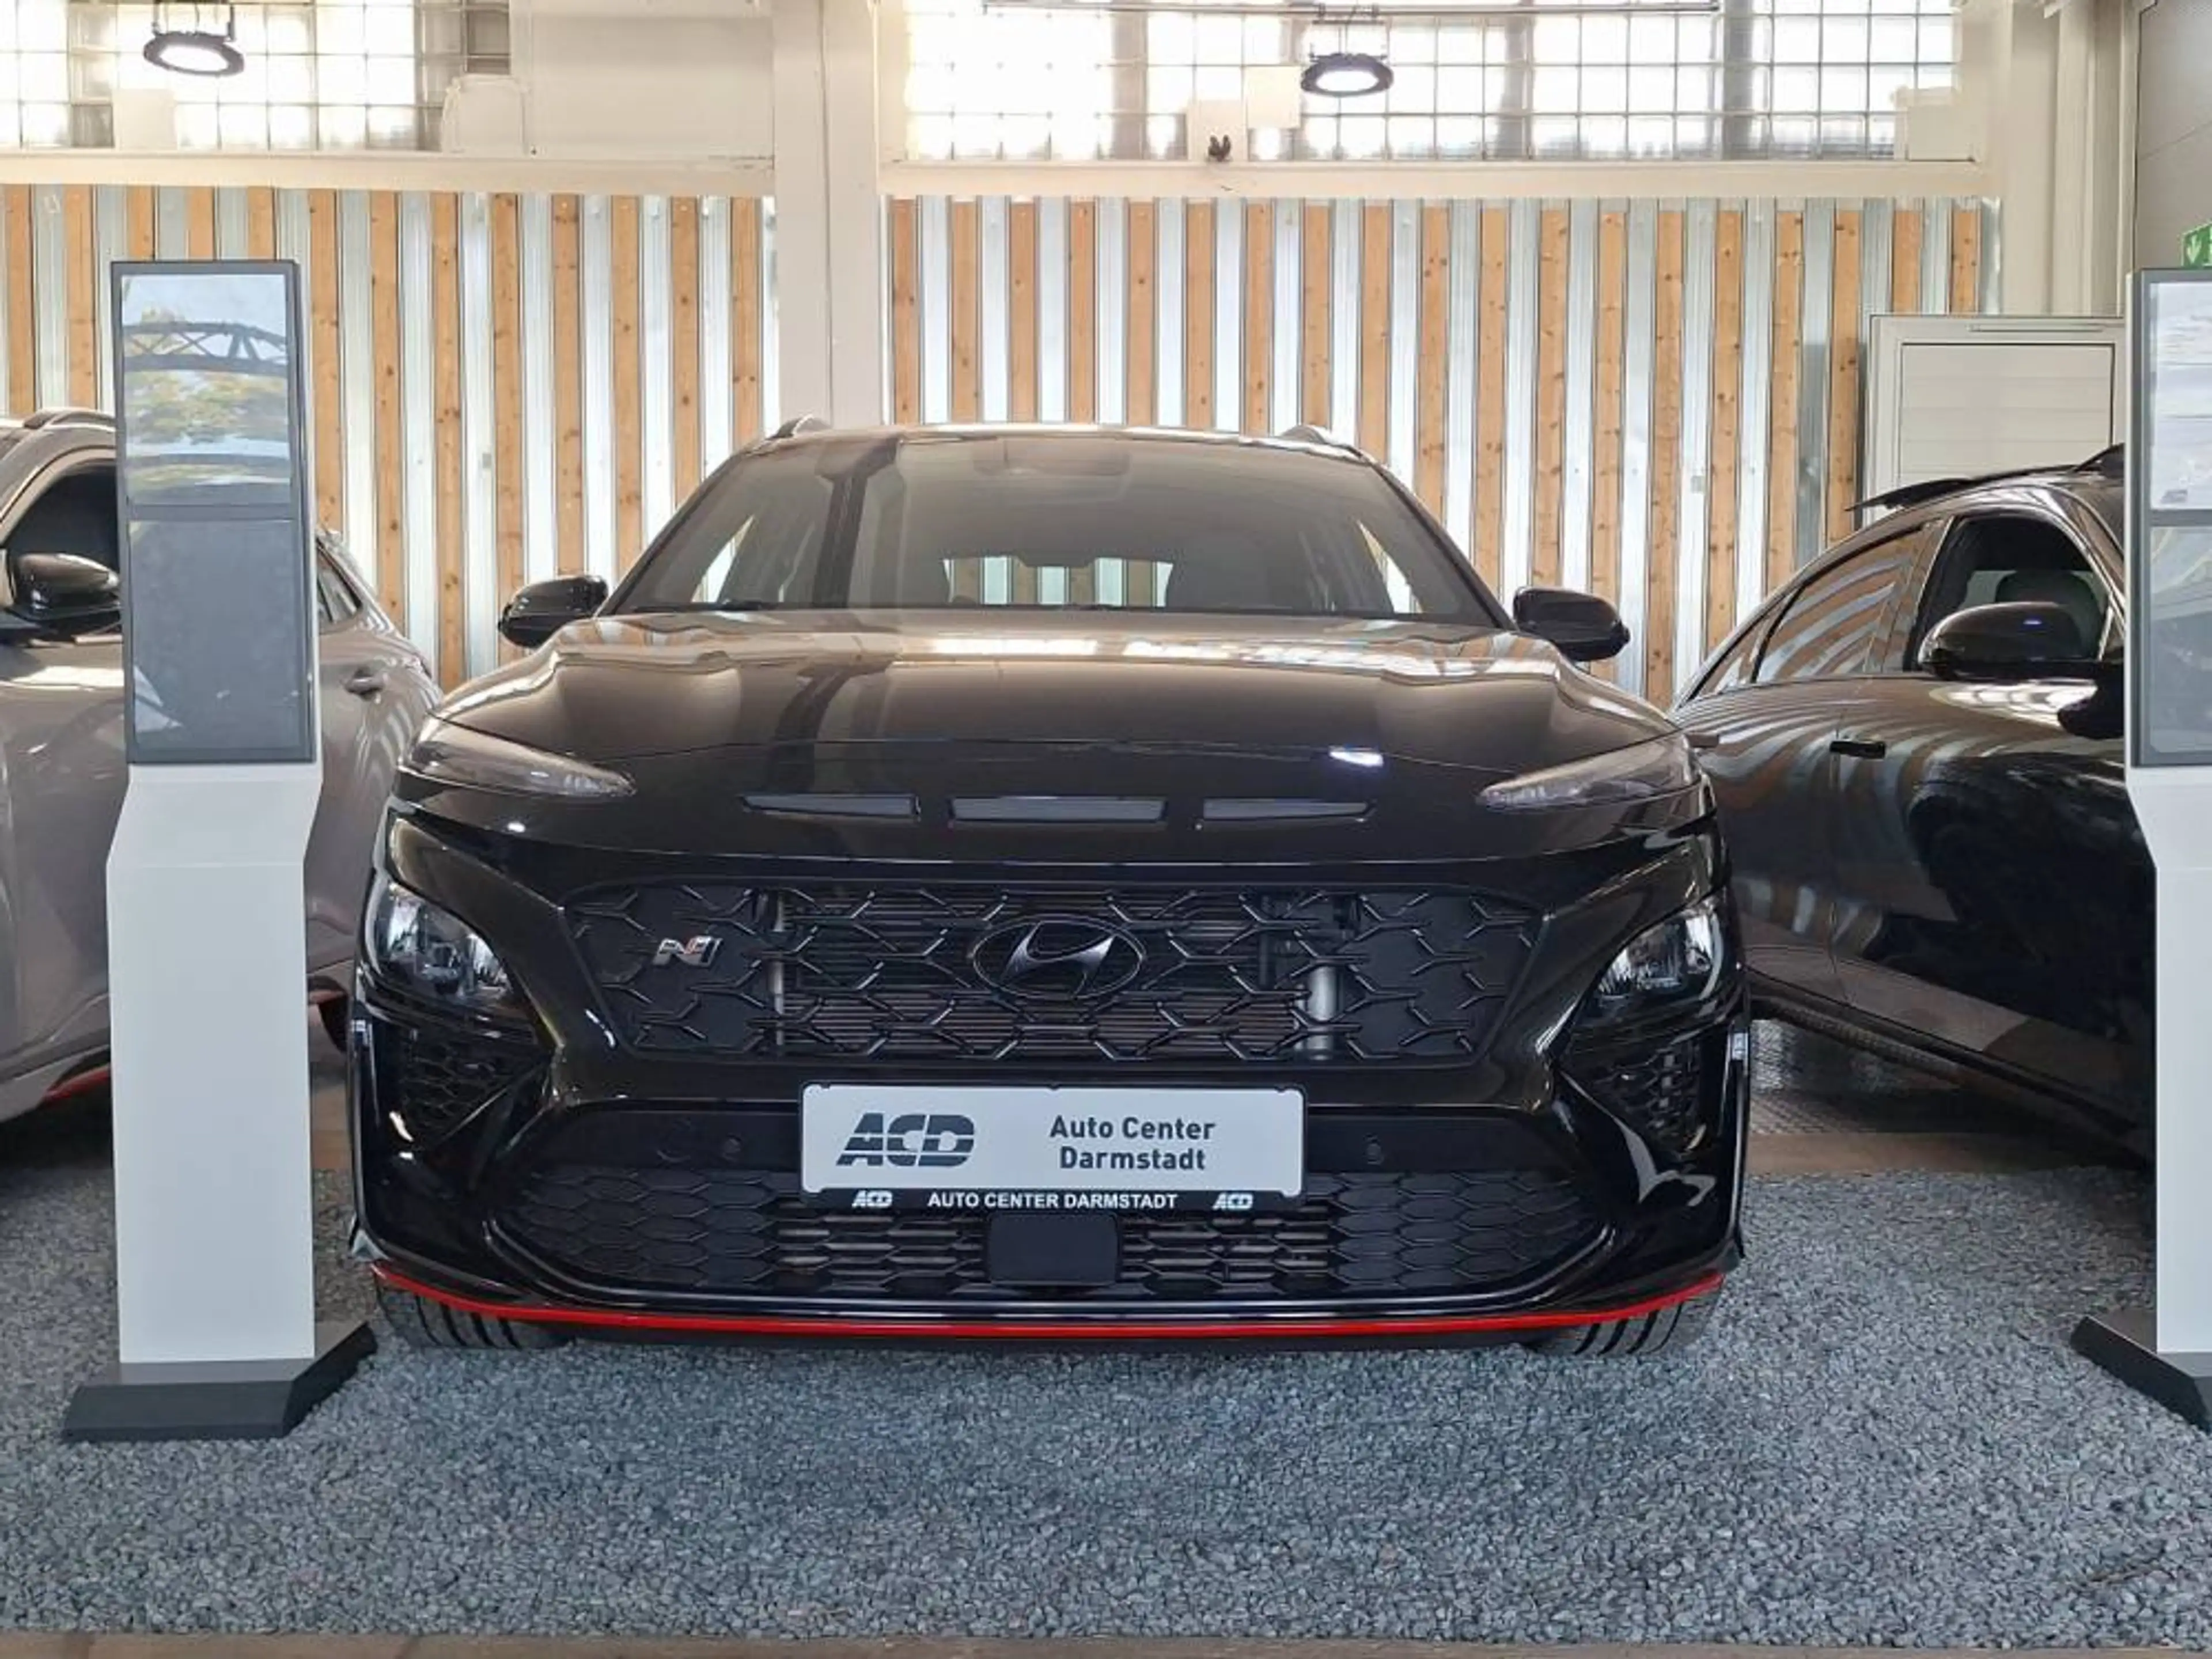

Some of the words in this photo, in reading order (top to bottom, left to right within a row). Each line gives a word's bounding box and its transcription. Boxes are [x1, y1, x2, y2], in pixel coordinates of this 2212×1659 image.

[1050, 1115, 1114, 1139] Auto
[1122, 1116, 1217, 1141] Center
[836, 1112, 975, 1168] ACD
[1059, 1146, 1206, 1171] Darmstadt
[851, 1190, 893, 1208] ACD
[927, 1191, 980, 1209] AUTO
[983, 1192, 1059, 1209] CENTER
[1063, 1192, 1178, 1210] DARMSTADT
[1211, 1192, 1254, 1210] ACD
